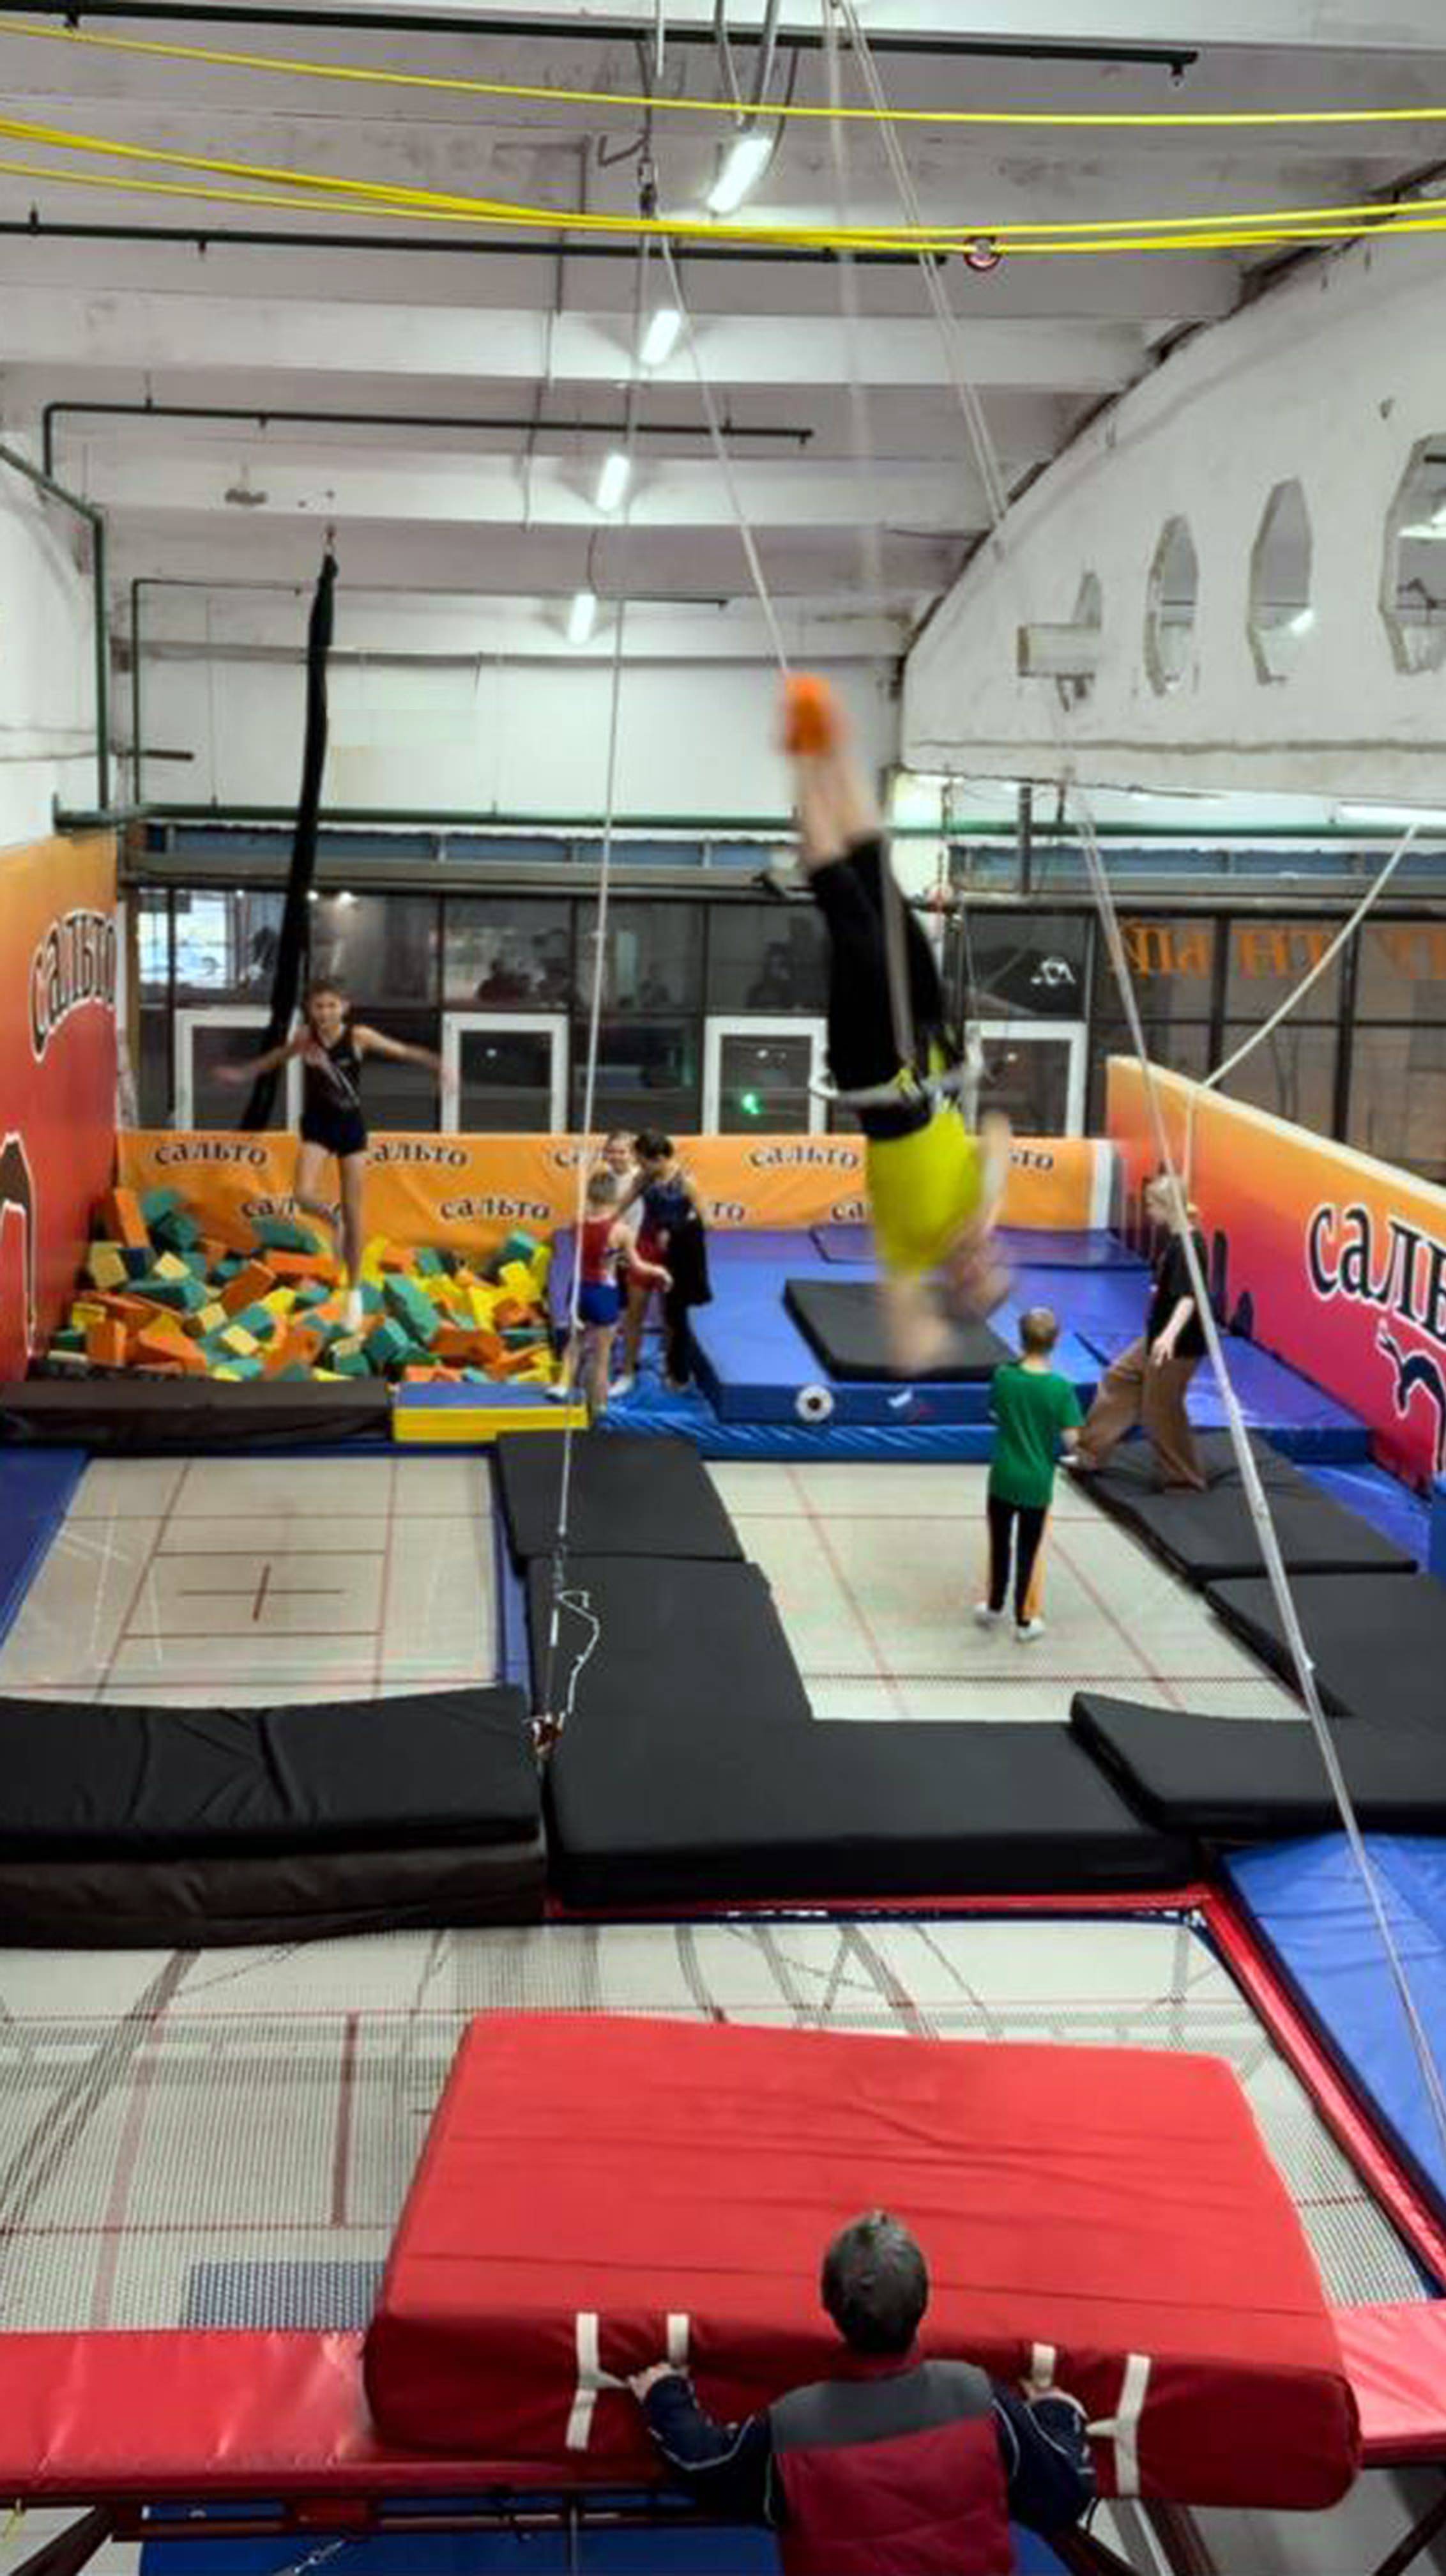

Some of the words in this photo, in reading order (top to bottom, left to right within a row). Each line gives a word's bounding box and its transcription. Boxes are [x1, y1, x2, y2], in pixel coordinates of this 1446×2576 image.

[155, 1143, 267, 1165] сальто
[370, 1143, 468, 1166] альто
[750, 1146, 858, 1169] сальто
[440, 1199, 550, 1220] сальто
